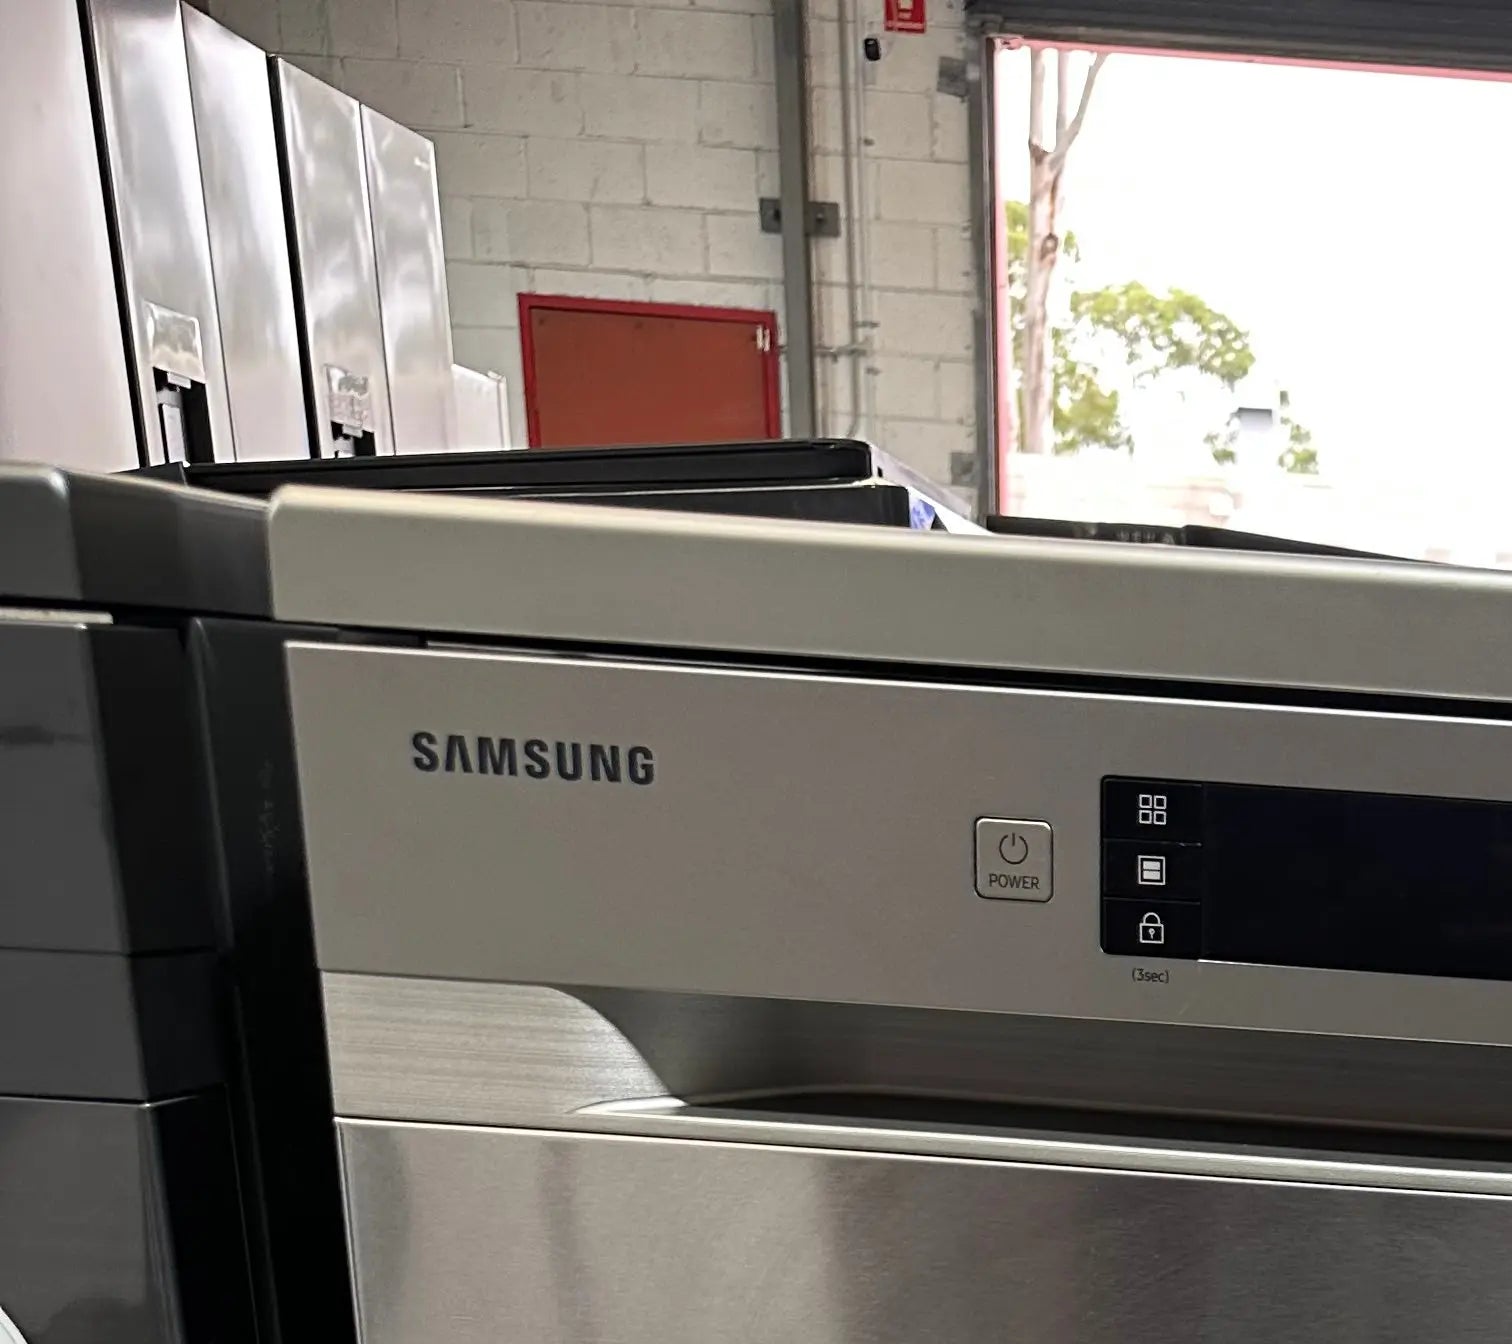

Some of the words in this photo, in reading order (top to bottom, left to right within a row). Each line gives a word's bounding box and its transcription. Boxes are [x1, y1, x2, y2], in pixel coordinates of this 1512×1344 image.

[412, 731, 655, 786] SAMSUNG
[988, 873, 1041, 891] POWER
[1131, 967, 1170, 985] (3sec)
